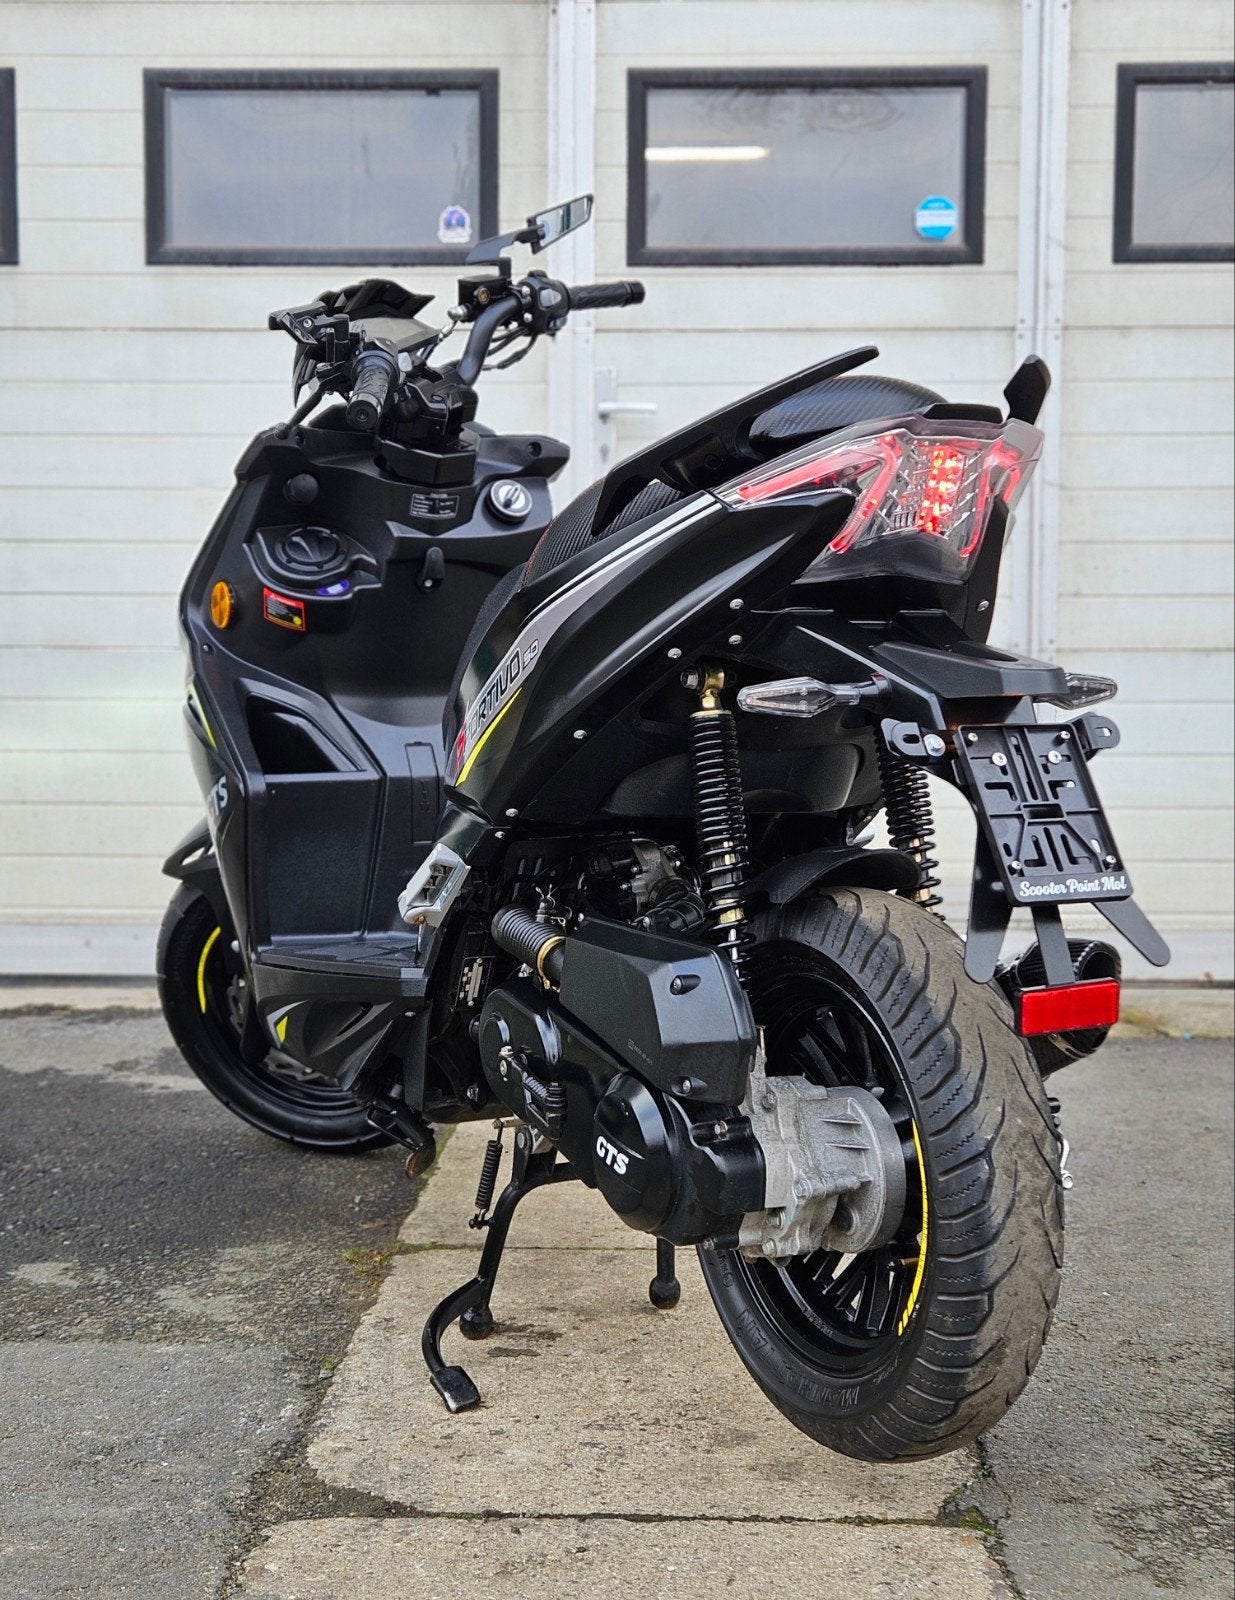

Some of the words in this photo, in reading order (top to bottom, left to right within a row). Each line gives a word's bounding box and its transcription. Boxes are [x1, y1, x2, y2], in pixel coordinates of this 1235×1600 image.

[522, 639, 540, 670] 50
[1020, 882, 1067, 897] Scooter
[1067, 878, 1100, 893] Point
[597, 1136, 629, 1175] GTS
